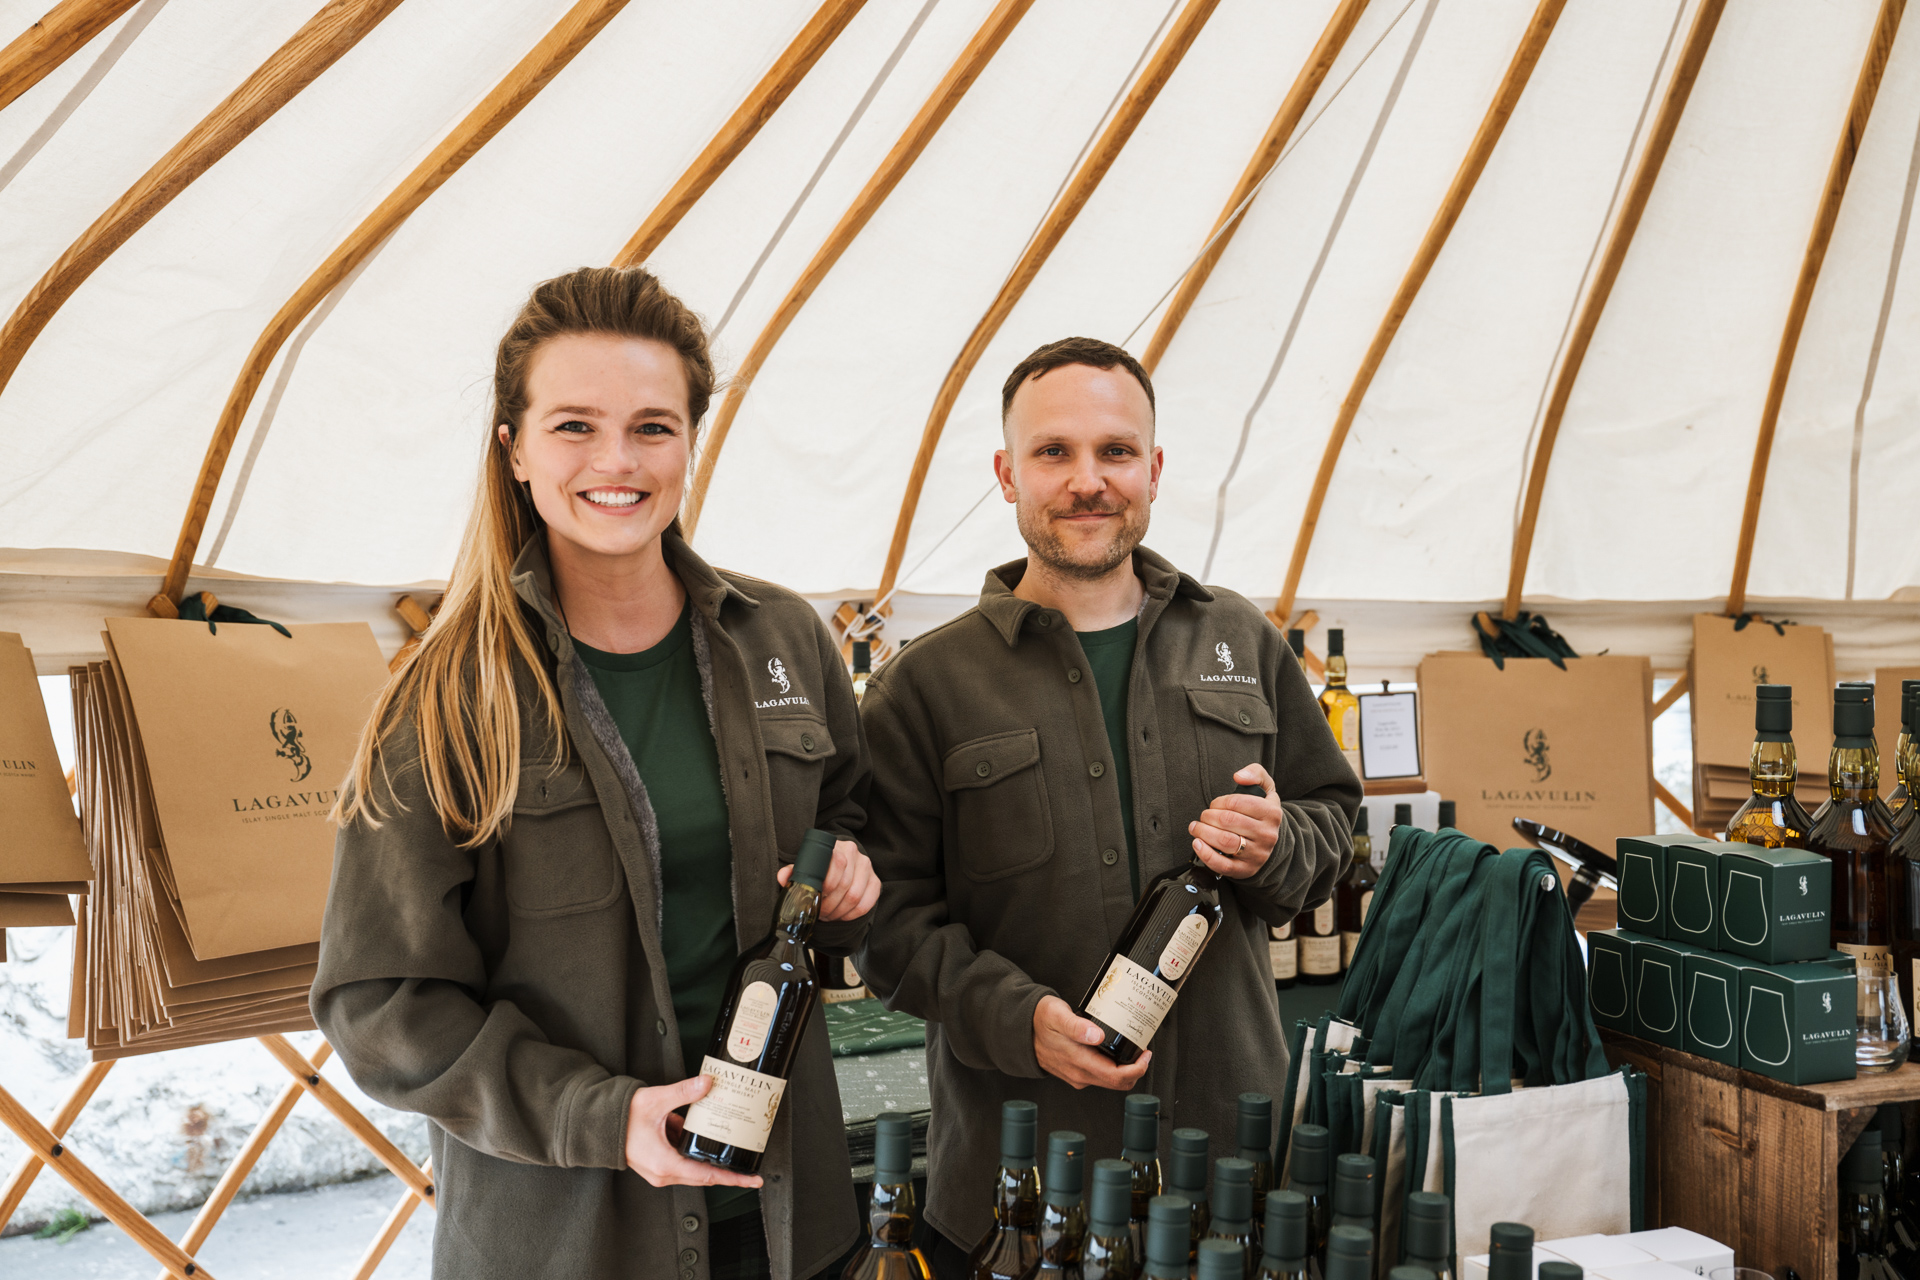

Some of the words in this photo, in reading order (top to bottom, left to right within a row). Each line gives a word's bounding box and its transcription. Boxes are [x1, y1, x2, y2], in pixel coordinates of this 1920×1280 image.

[1200, 674, 1257, 685] LAGAVULIN
[232, 790, 340, 812] LAGAVUL
[1481, 789, 1598, 802] LAGAVULIN
[264, 814, 290, 822] SINGLE
[293, 811, 311, 819] MALT
[1780, 911, 1826, 922] LAGAVULIN
[1170, 958, 1180, 968] 14
[1802, 1029, 1851, 1041] LAGAVULIN
[740, 1037, 751, 1046] 14
[703, 1063, 773, 1091] LAGAVULIN
